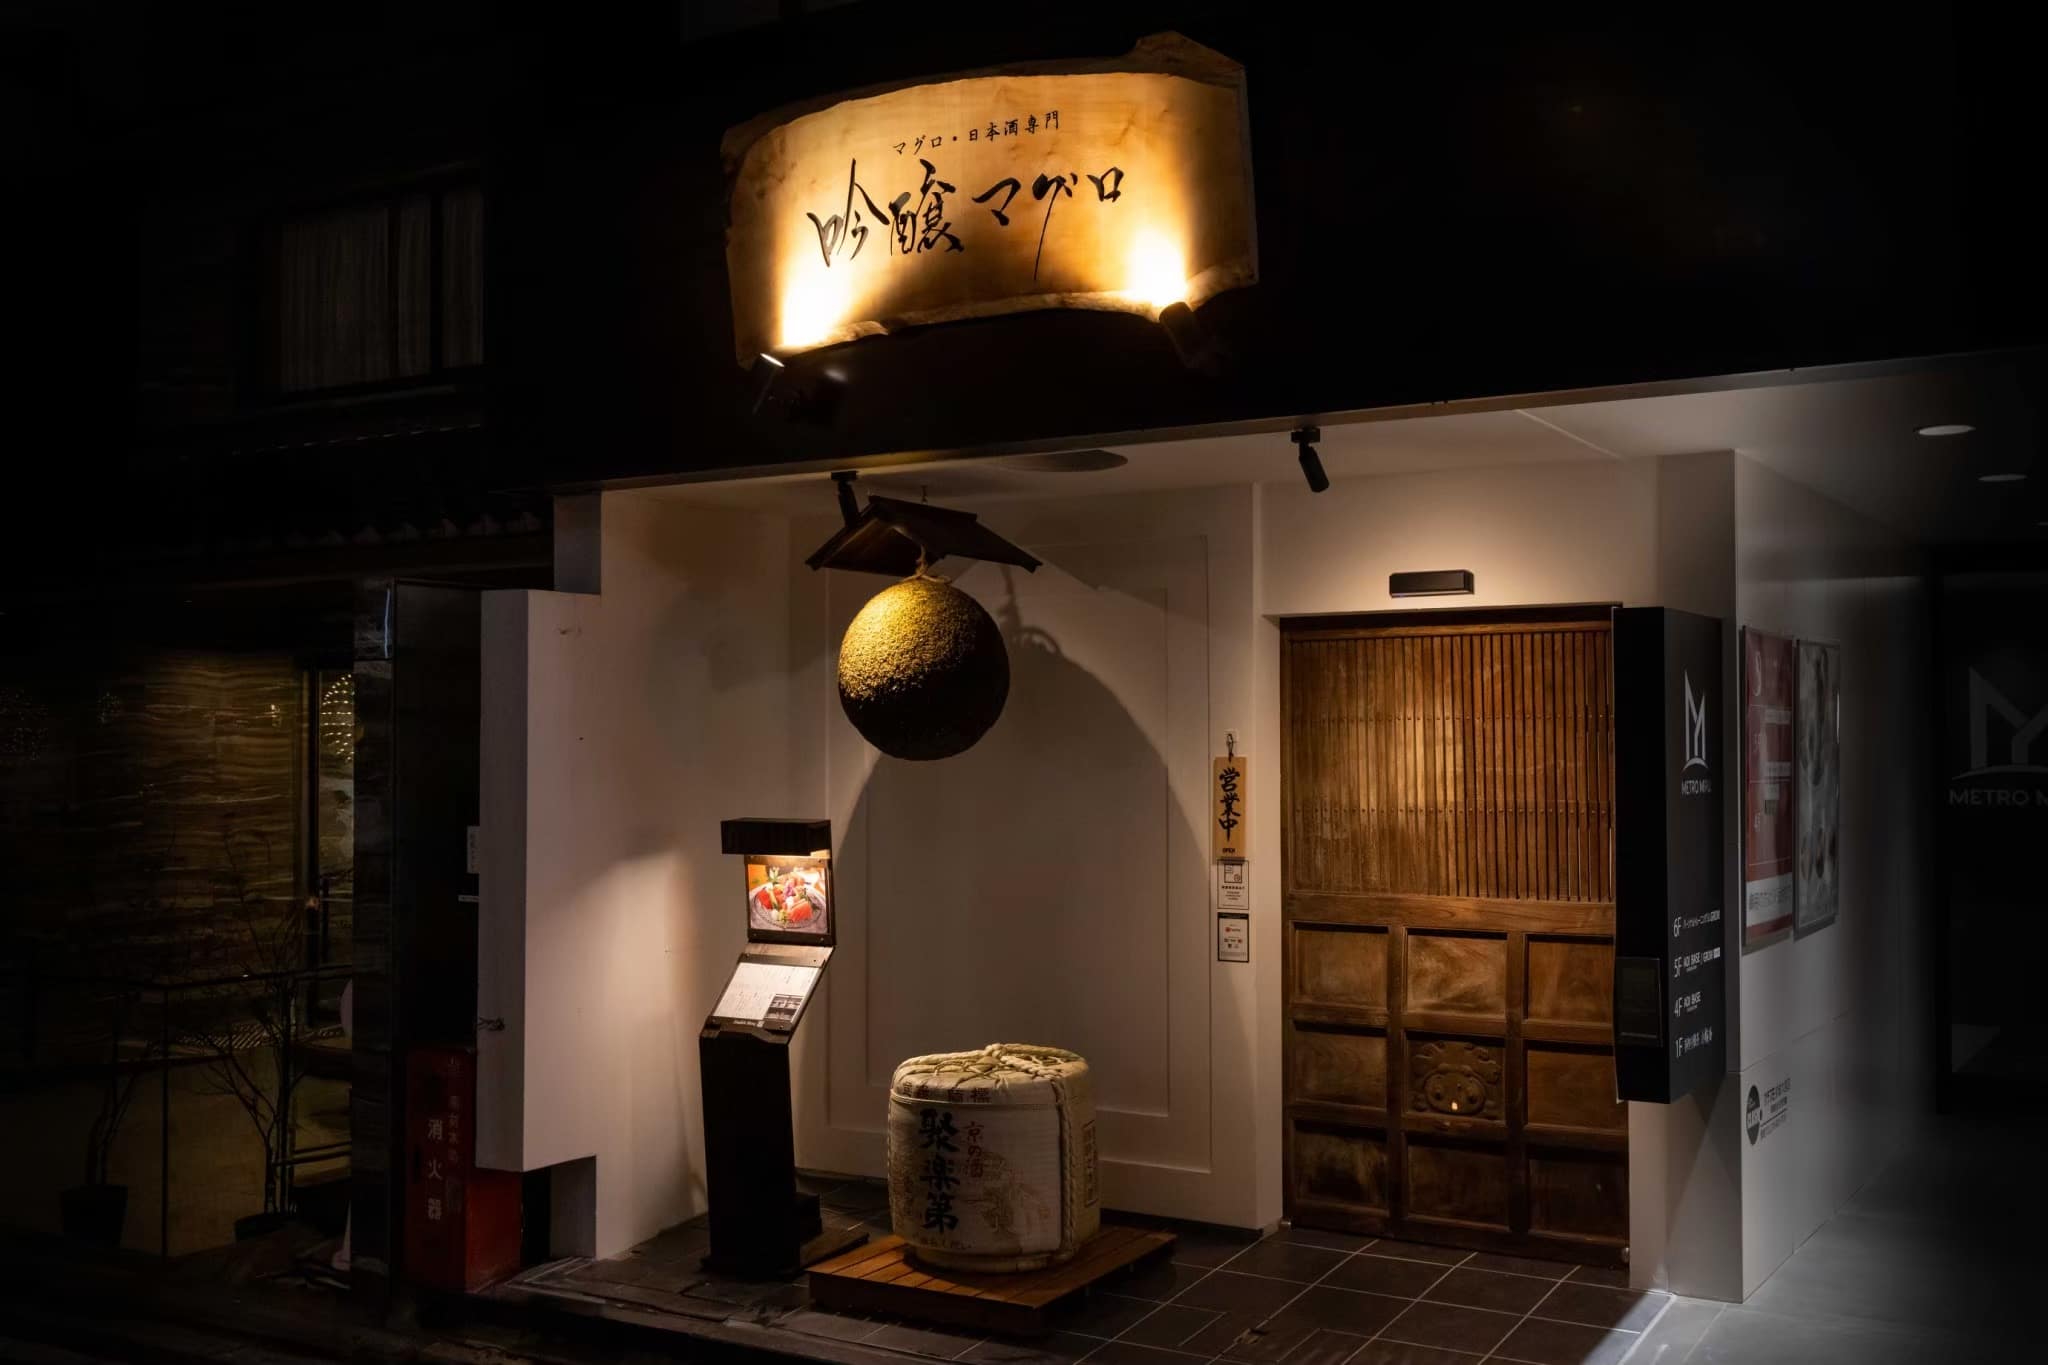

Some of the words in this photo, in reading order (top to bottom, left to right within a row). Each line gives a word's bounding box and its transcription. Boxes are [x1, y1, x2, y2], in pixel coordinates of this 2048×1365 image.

[893, 110, 1059, 155] マグロ・日本酒専門
[1681, 779, 1699, 795] METRO
[1949, 788, 2030, 806] METRO
[1219, 767, 1240, 841] 営業中
[1673, 916, 1682, 938] 6F
[1674, 956, 1682, 978] 5F
[1674, 997, 1682, 1017] 4F
[1676, 1037, 1683, 1059] 1F
[426, 1118, 445, 1221] 消火器
